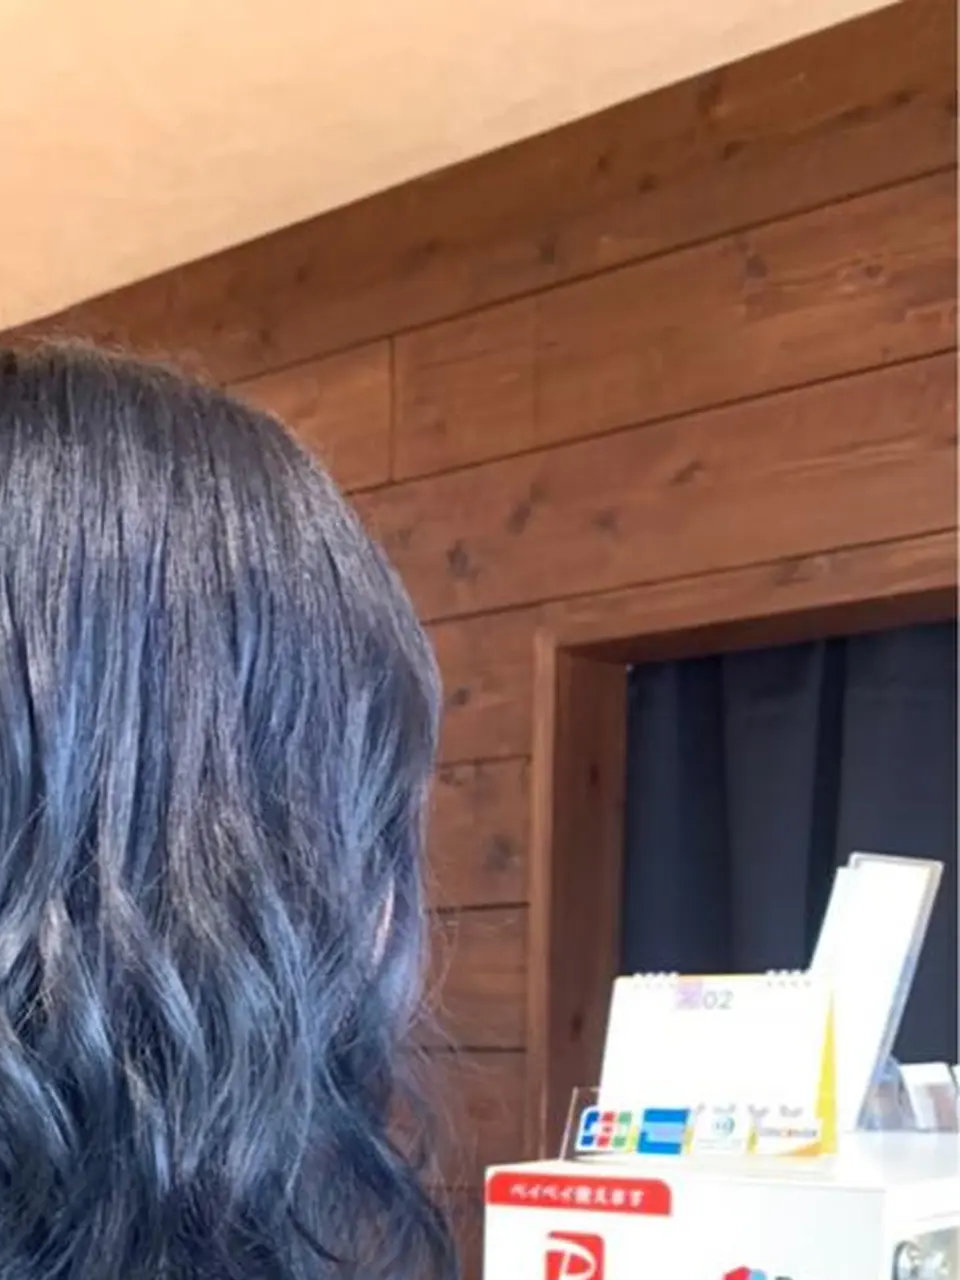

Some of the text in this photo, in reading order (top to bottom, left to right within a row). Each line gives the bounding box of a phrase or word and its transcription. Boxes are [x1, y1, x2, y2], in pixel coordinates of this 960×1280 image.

[509, 1182, 645, 1207] ペイペイえます
